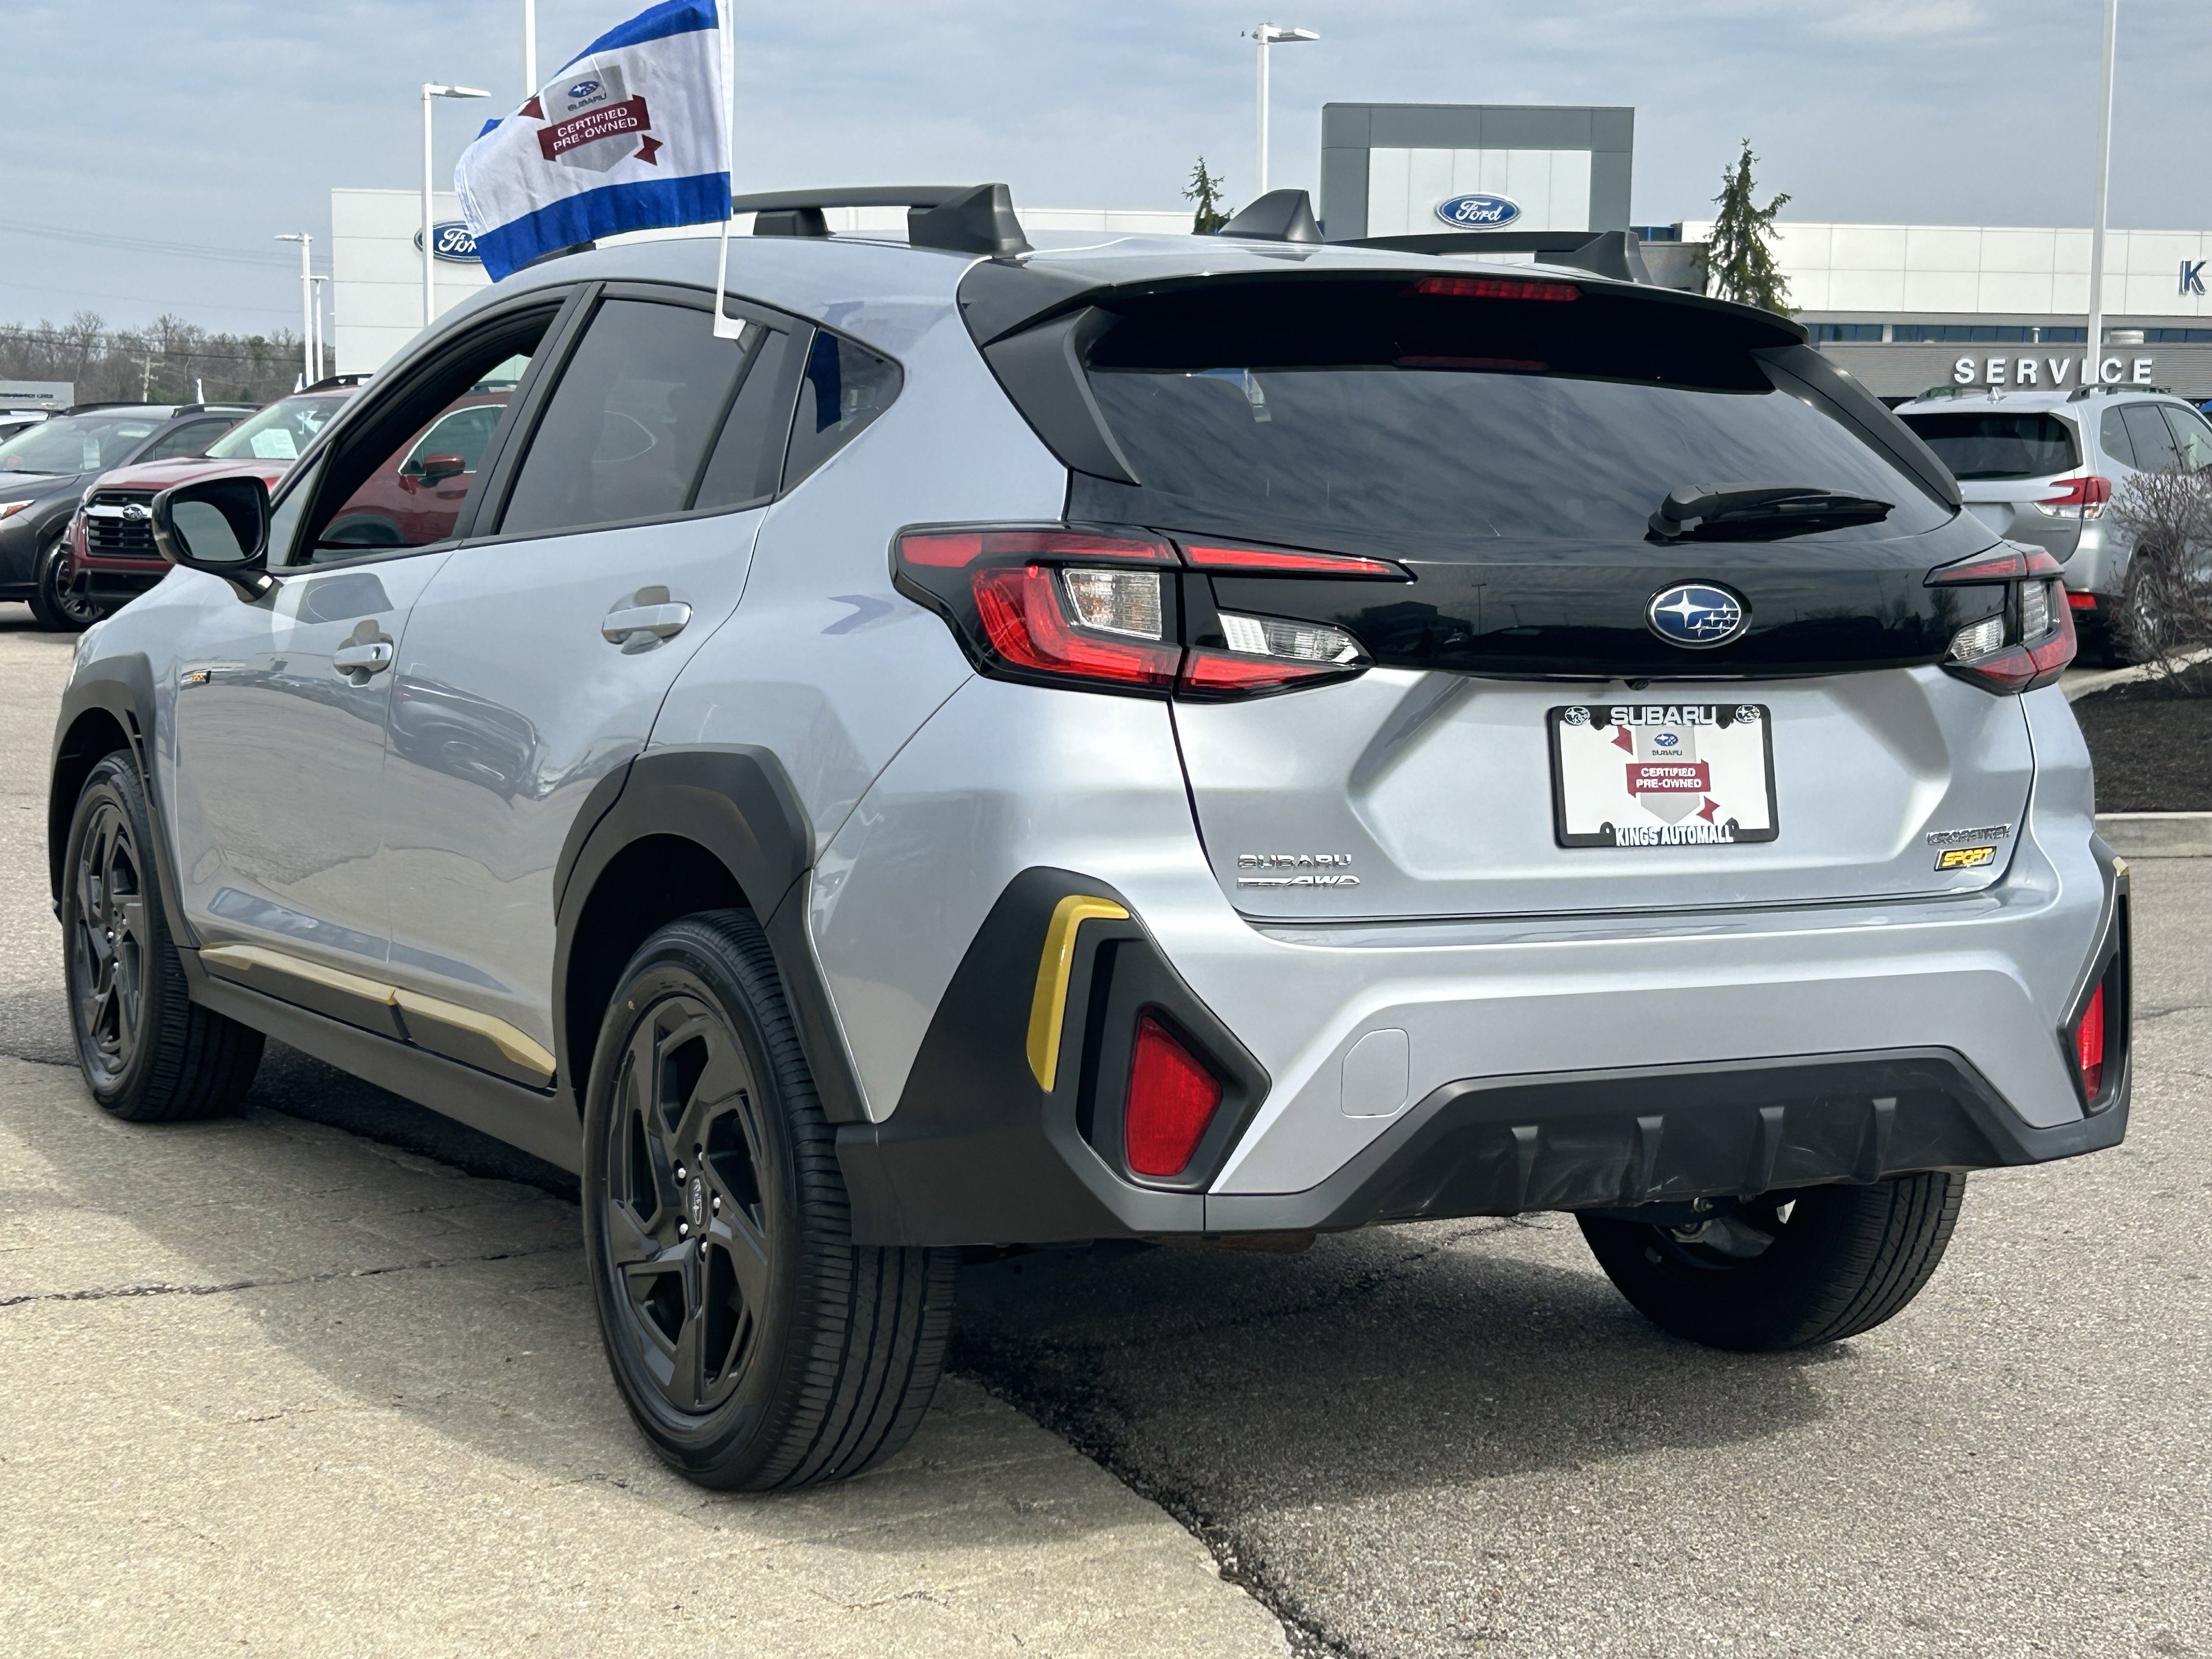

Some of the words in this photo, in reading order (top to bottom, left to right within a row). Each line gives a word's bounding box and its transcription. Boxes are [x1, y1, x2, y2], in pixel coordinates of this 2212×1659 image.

[567, 92, 607, 111] SUBARU
[557, 107, 628, 137] CERTIFIED
[553, 117, 637, 151] PRE-OWNED
[1455, 200, 1505, 221] Ford
[438, 228, 477, 253] For
[1954, 358, 2153, 384] SERVICE
[1611, 706, 1716, 725] SUBARU
[1641, 768, 1696, 777] CERTIFIED
[1635, 778, 1702, 788] PRE-OWNED
[1615, 826, 1658, 846] KINGS
[1660, 824, 1734, 845] AUTOMALL
[1238, 854, 1352, 869] SUBARU
[1942, 848, 1993, 867] SPORT
